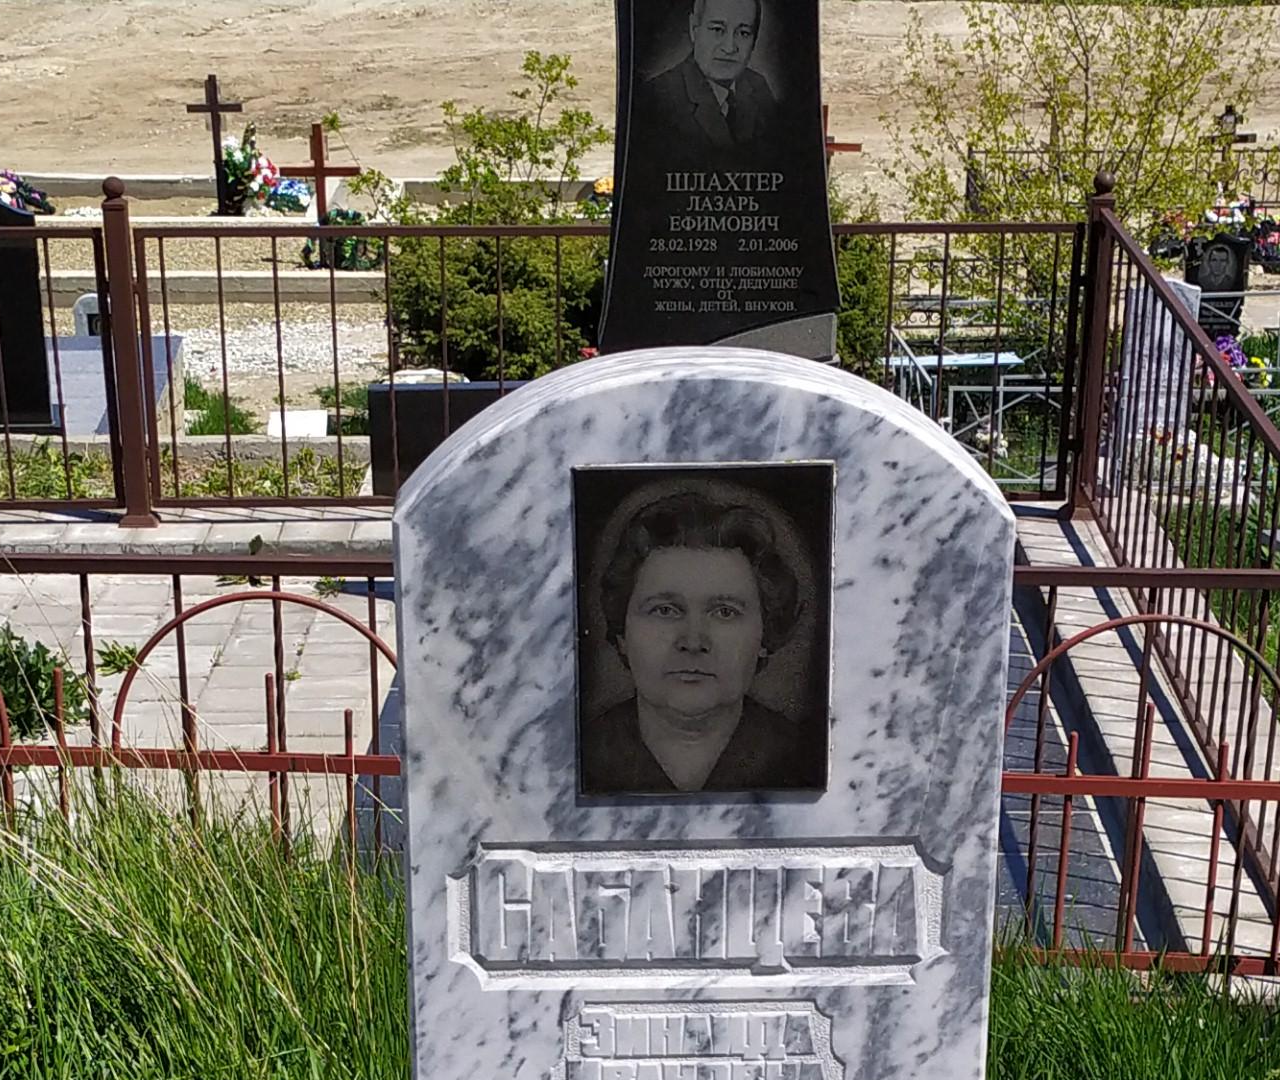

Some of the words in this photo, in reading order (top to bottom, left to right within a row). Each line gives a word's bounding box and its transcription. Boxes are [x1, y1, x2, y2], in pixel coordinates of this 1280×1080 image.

[666, 172, 784, 191] ШЛАХТЕР
[686, 196, 759, 212] ЛАЗАРЬ
[670, 216, 780, 231] ЕФИМОВИЧ
[649, 238, 718, 251] 28.02.1928
[738, 238, 799, 251] 2.01.2006
[643, 266, 710, 278] ДОРОГОМУ
[716, 266, 725, 277] И
[730, 266, 804, 278] ЛЮБИМОМУ
[653, 278, 695, 289] МУЖУ,
[700, 278, 737, 289] ОТЦУ,
[738, 278, 799, 289] ДЕДУШКЕ
[717, 290, 734, 300] ОТ
[655, 301, 695, 312] ЖЕНЫ,
[699, 300, 741, 312] ДЕТЕЙ,
[745, 301, 798, 312] ВНУКОВ.
[475, 853, 923, 972] САБАНЦЕВА
[579, 1009, 817, 1061] ЗИНАИДА
